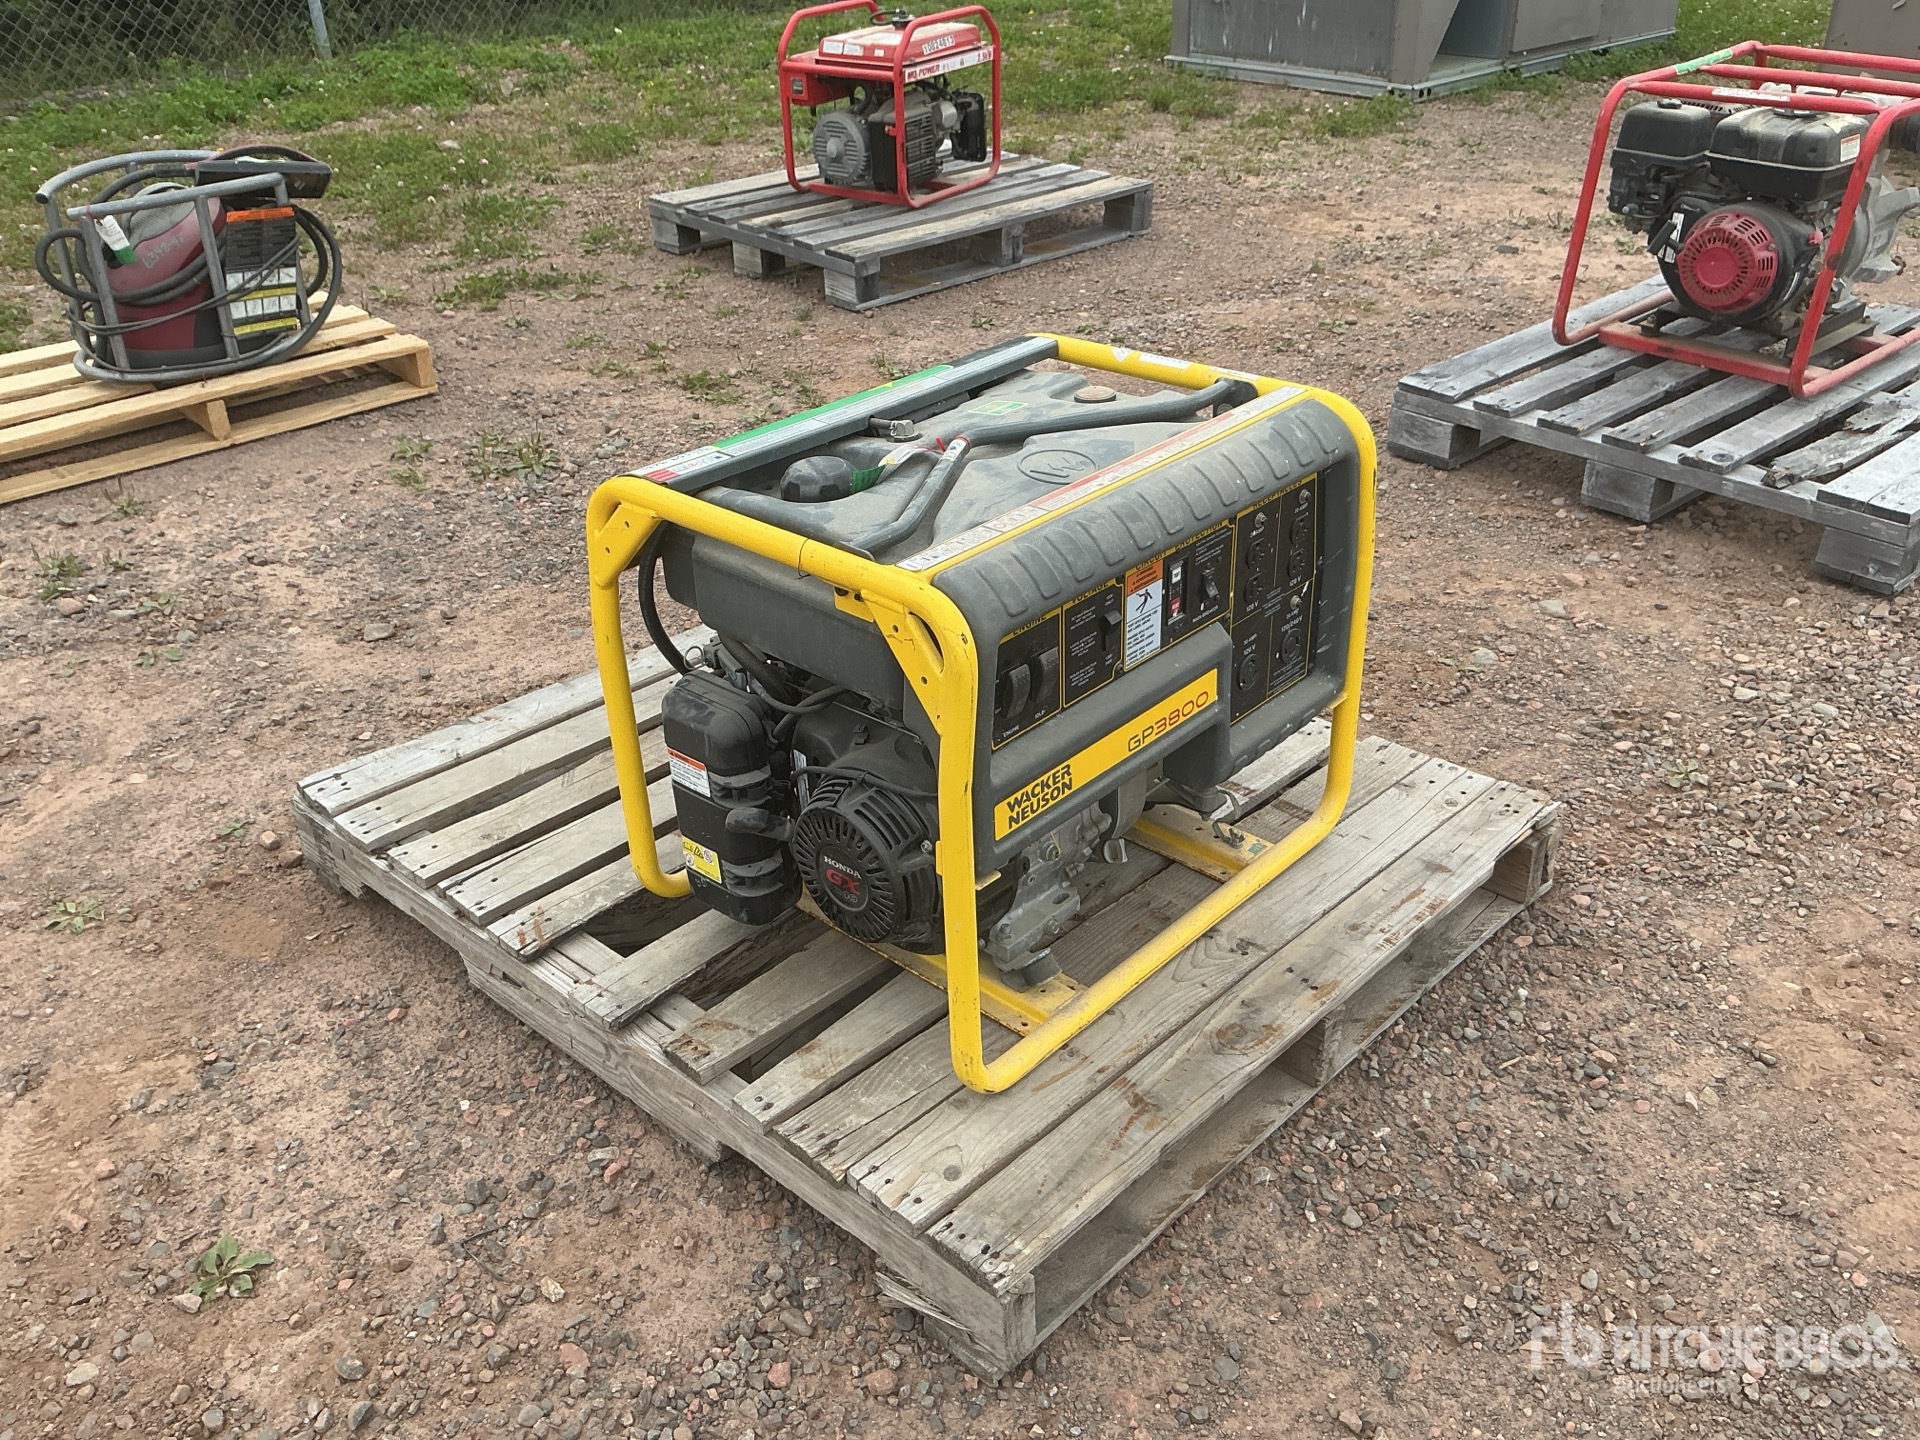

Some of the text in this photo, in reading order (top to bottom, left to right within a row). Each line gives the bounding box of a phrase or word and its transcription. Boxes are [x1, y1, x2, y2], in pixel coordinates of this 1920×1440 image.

[918, 64, 940, 77] POWER
[1246, 603, 1254, 612] 120
[1243, 646, 1252, 655] 120
[1128, 690, 1209, 753] GP3800
[1006, 763, 1073, 814] WACKER
[1008, 777, 1073, 830] NEUSON
[823, 855, 862, 880] HONDA
[826, 868, 860, 896] GX
